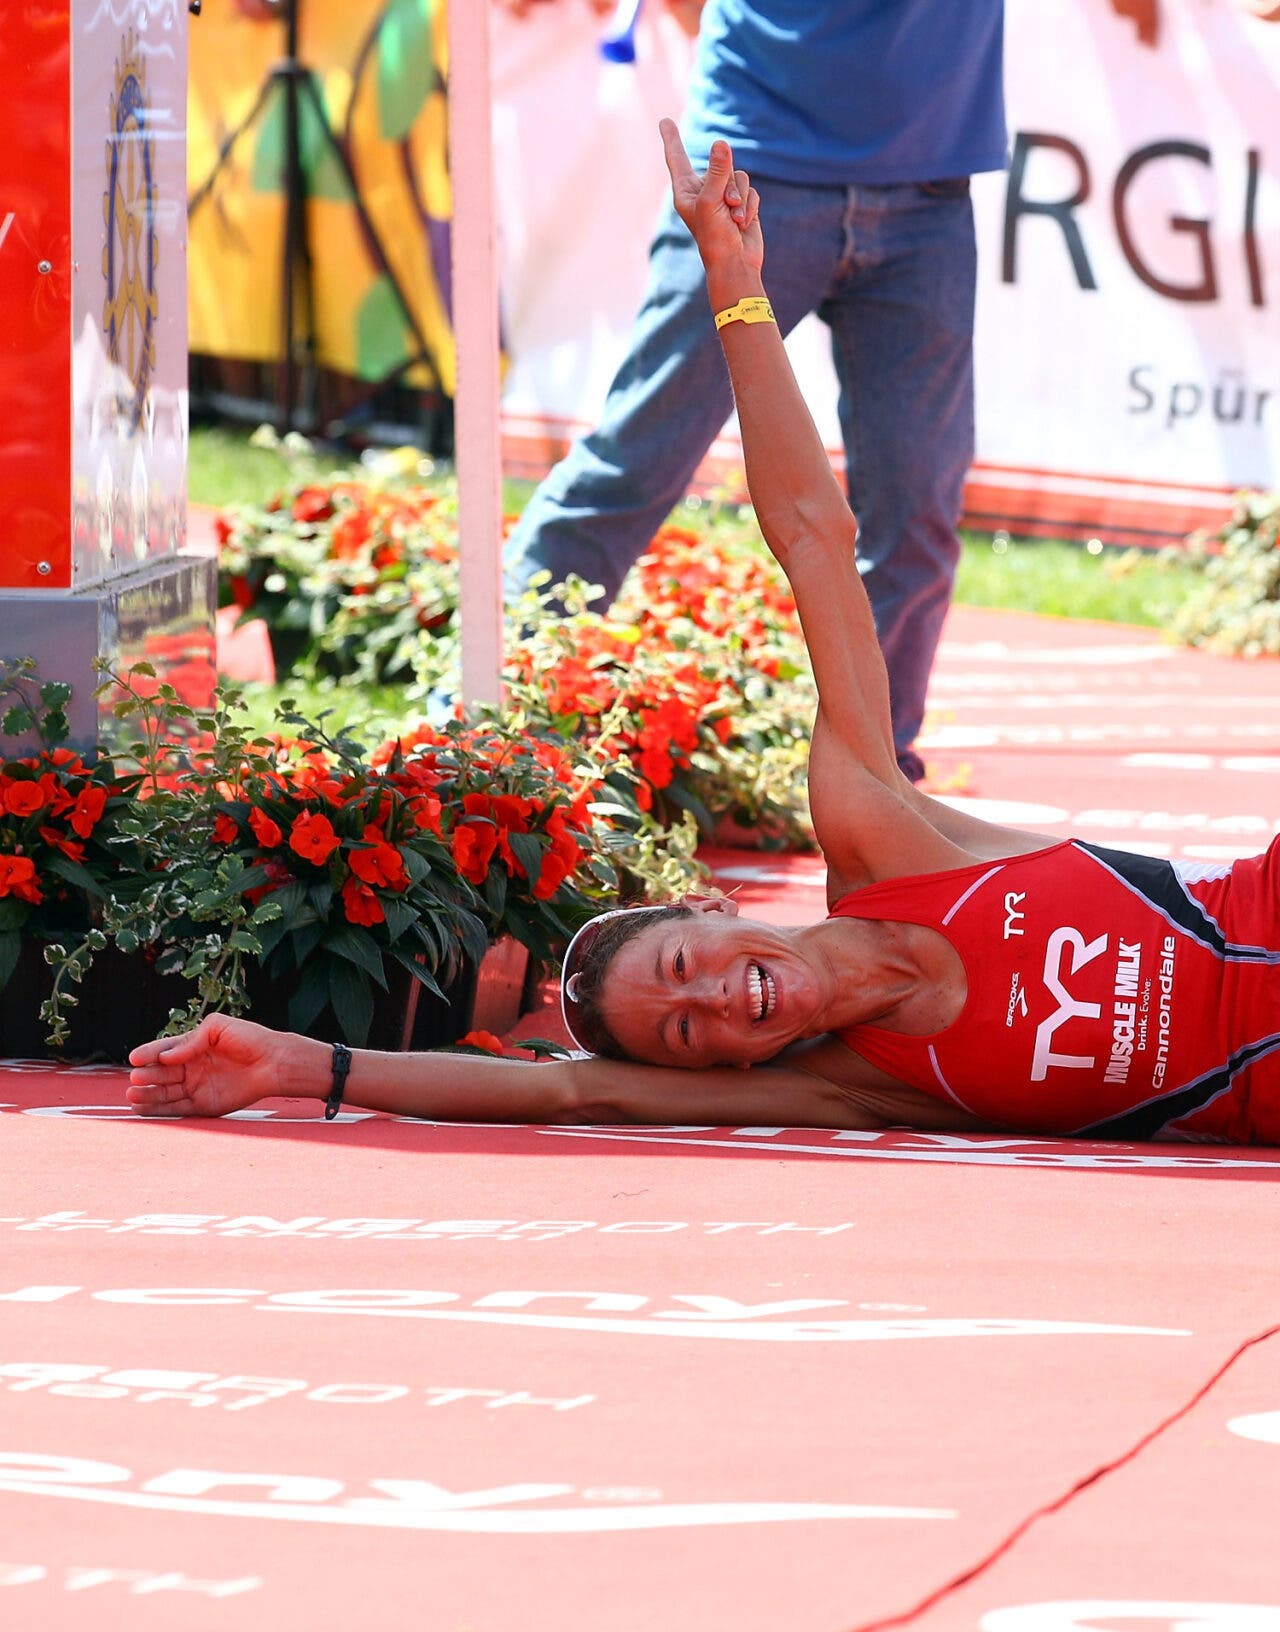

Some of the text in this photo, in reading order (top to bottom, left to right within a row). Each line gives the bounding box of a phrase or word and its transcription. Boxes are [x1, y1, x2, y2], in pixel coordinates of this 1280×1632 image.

[1003, 891, 1026, 940] TYR
[1030, 926, 1109, 1081] TYR
[1103, 938, 1142, 1084] MUSCLE MILK
[1137, 1014, 1148, 1051] Drink.
[1151, 935, 1176, 1090] cannondale
